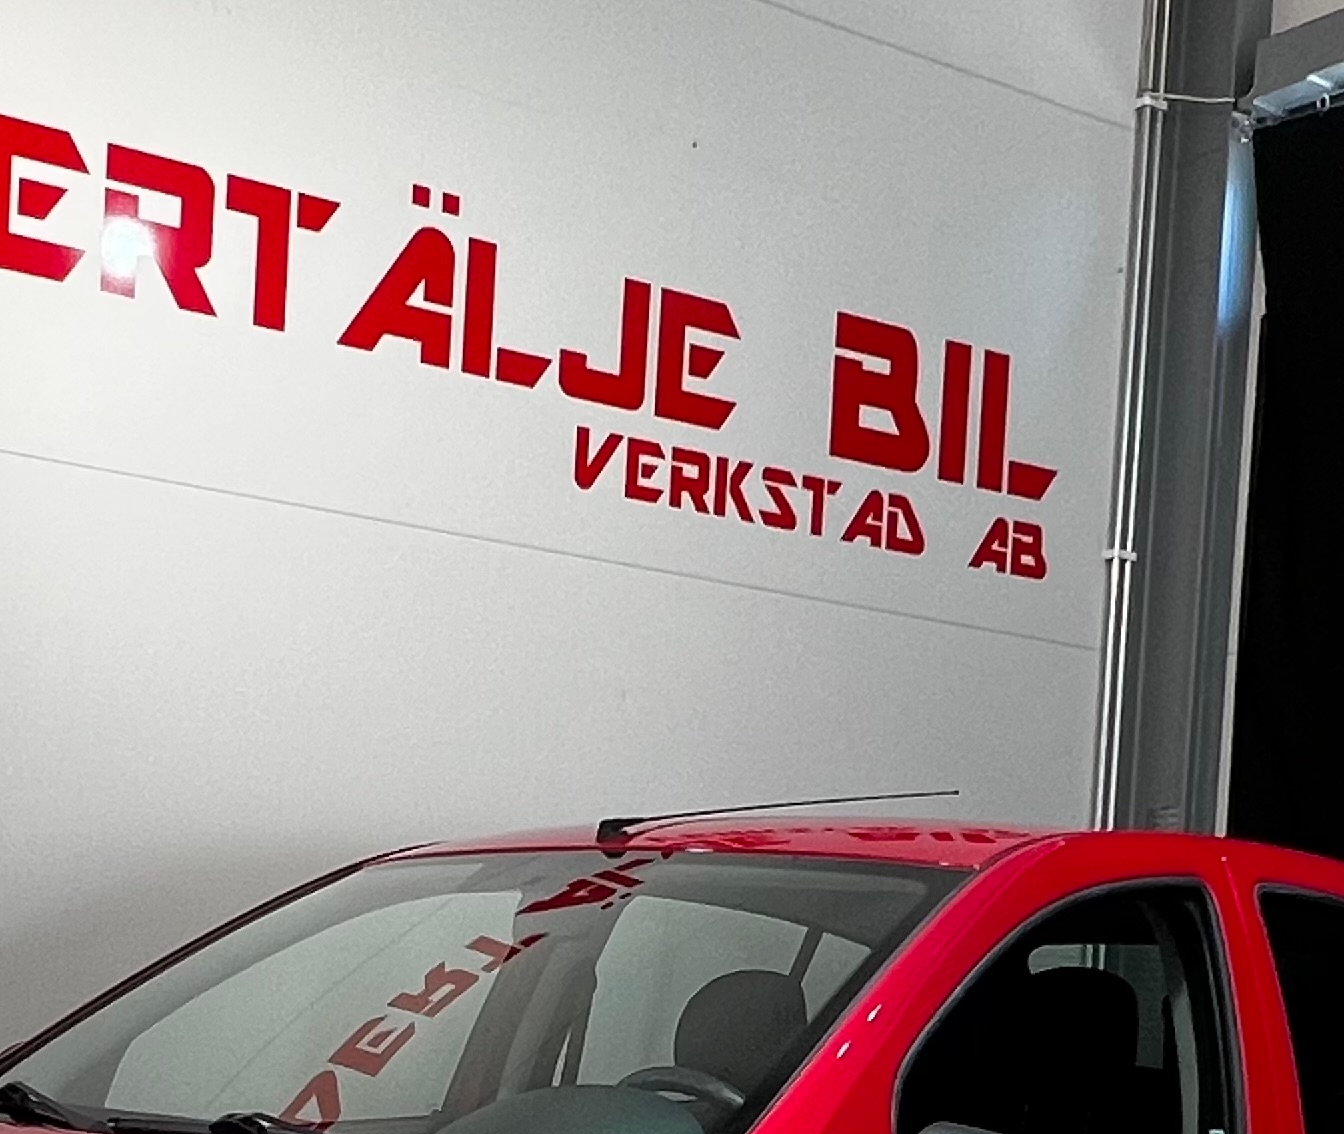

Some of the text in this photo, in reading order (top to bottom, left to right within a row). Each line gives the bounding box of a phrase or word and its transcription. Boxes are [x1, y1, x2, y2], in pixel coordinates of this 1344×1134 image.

[829, 311, 1058, 501] BIL
[574, 425, 1048, 580] VERKSTAD AB
